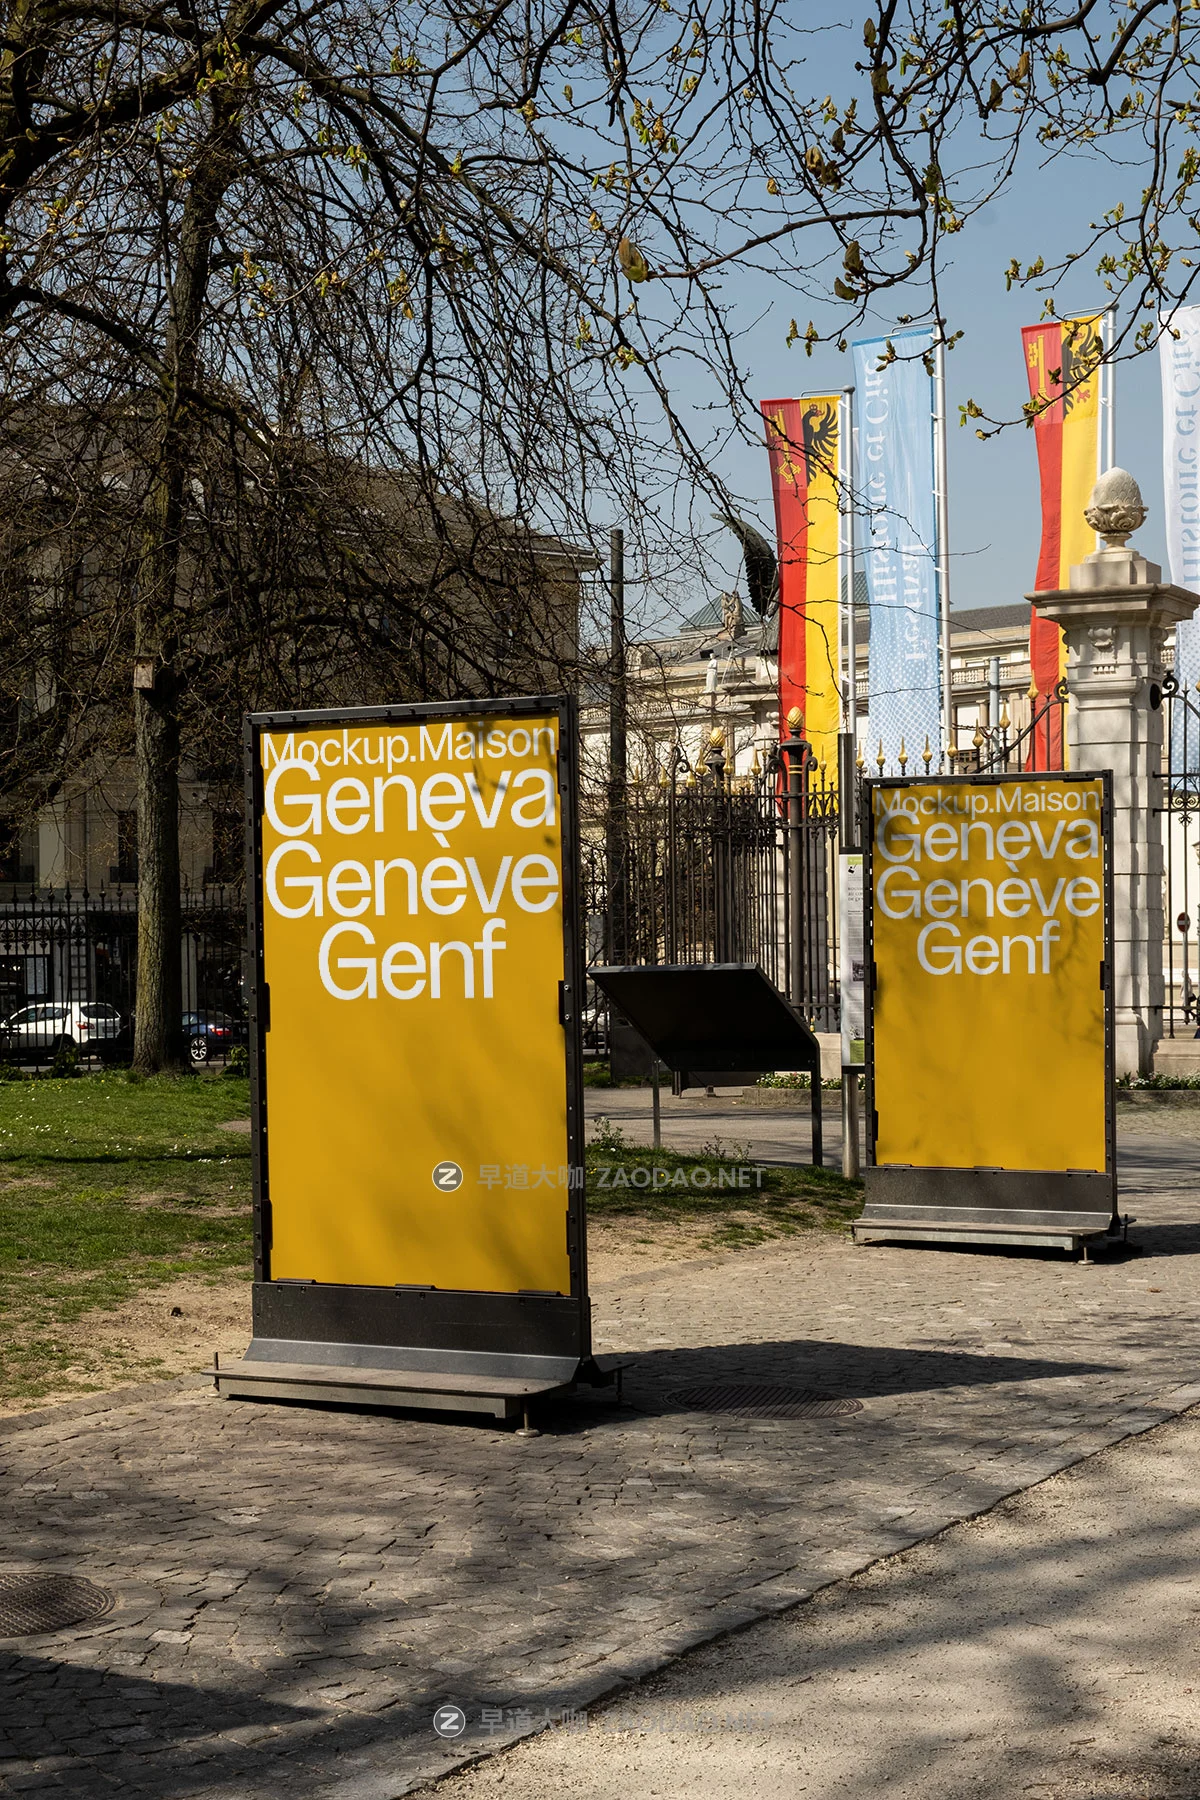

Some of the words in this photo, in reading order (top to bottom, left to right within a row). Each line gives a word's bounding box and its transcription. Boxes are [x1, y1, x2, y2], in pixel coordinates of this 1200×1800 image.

[263, 722, 555, 773] Mockup.Maison
[265, 758, 557, 837] Geneva
[875, 786, 1100, 820] Mockup.Maison
[876, 809, 1099, 863] Geneva
[265, 832, 559, 919] Genève
[876, 860, 1101, 920] Genève
[318, 918, 507, 1001] Genf
[916, 919, 1061, 976] Genf
